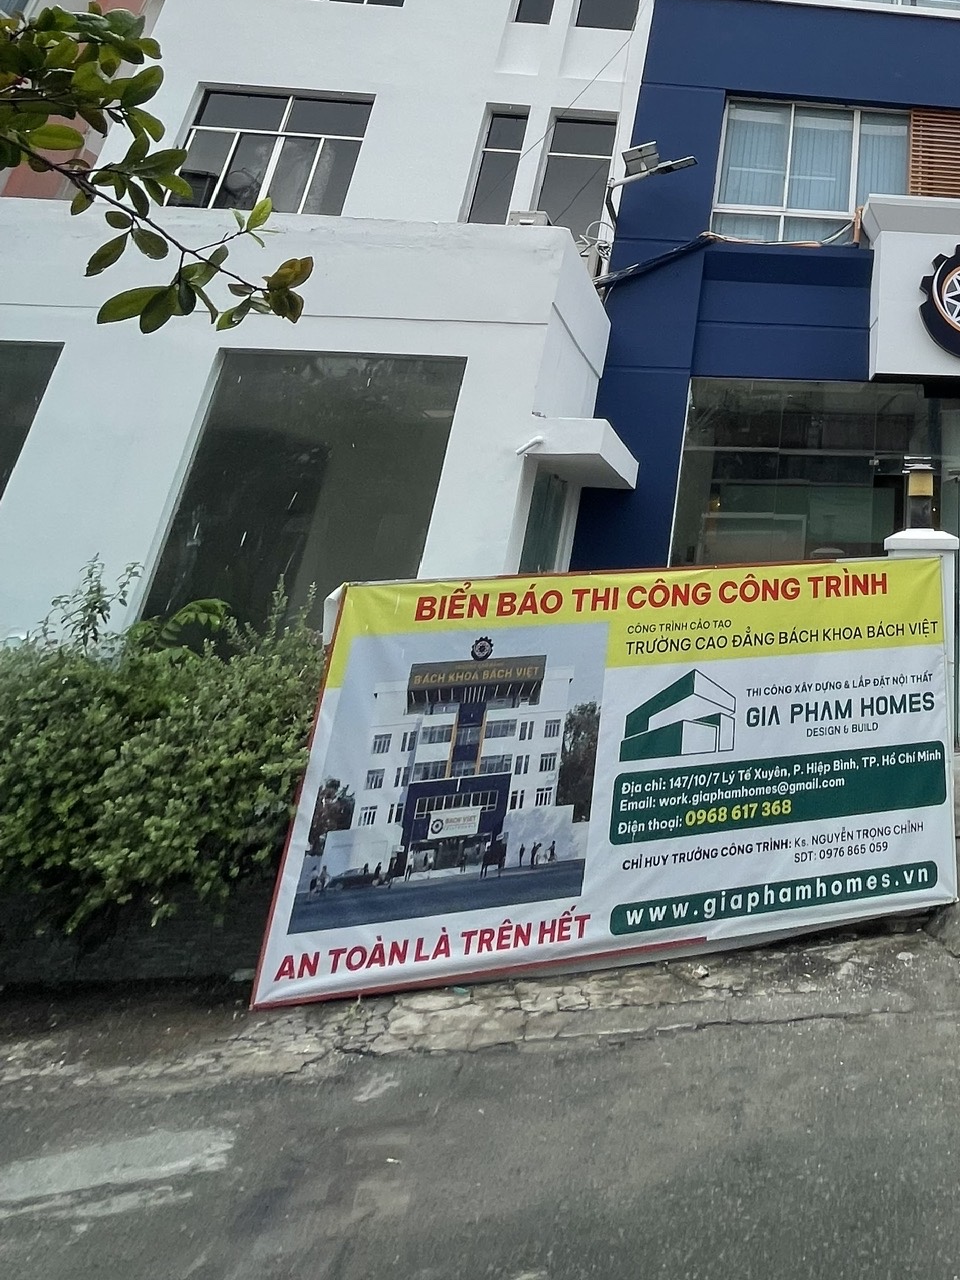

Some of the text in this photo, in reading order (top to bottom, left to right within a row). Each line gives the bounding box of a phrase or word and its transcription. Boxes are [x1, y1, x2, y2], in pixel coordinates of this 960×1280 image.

[414, 568, 888, 621] BIỂN BÁO THI CÔNG CÔNG TRÌNH
[626, 618, 938, 655] TRƯỜNG CAO ĐẲNG BÁCH KHOA BÁCH VIỆT
[627, 622, 656, 634] CÔNG
[659, 620, 688, 632] TRÌNH
[712, 619, 732, 631] TẠO
[448, 671, 479, 683] KHOA
[746, 686, 762, 697] THI
[763, 684, 792, 696] CÔNG
[794, 681, 812, 693] XÂY
[815, 680, 842, 694] DỰNG
[843, 680, 850, 689] &
[911, 670, 933, 684] THẤT
[746, 705, 780, 728] GIA
[861, 691, 935, 718] HOMES
[806, 725, 841, 737] DESIGN
[852, 722, 879, 733] BUILD
[621, 781, 642, 797] Địa
[644, 776, 667, 792] chỉ:
[669, 772, 720, 790] 147/10/7
[722, 771, 736, 786] Lý
[738, 766, 753, 781] Tế
[754, 765, 791, 781] Xuyên,
[793, 764, 804, 776] P.
[806, 761, 831, 776] Hiệp
[833, 758, 859, 771] Bình,
[861, 755, 880, 768] TP.
[898, 751, 915, 765] Chí
[917, 749, 942, 762] Minh
[619, 776, 845, 812] Email: work.giaphamhomes@gmail.com
[617, 799, 792, 835] Điện thoại: 0968 617 368
[645, 854, 669, 868] HUY
[720, 842, 753, 857] CÔNG
[756, 837, 792, 853] TRÌNH:
[794, 837, 809, 848] Ks.
[811, 827, 854, 846] NGUYỄN
[856, 827, 891, 841] TRỌNG
[794, 841, 888, 863] SDT: 0976 865 059
[626, 865, 929, 926] www.giaphamhomes.vn
[273, 905, 591, 982] AN TOÀN LÀ TRÊN HẾT
